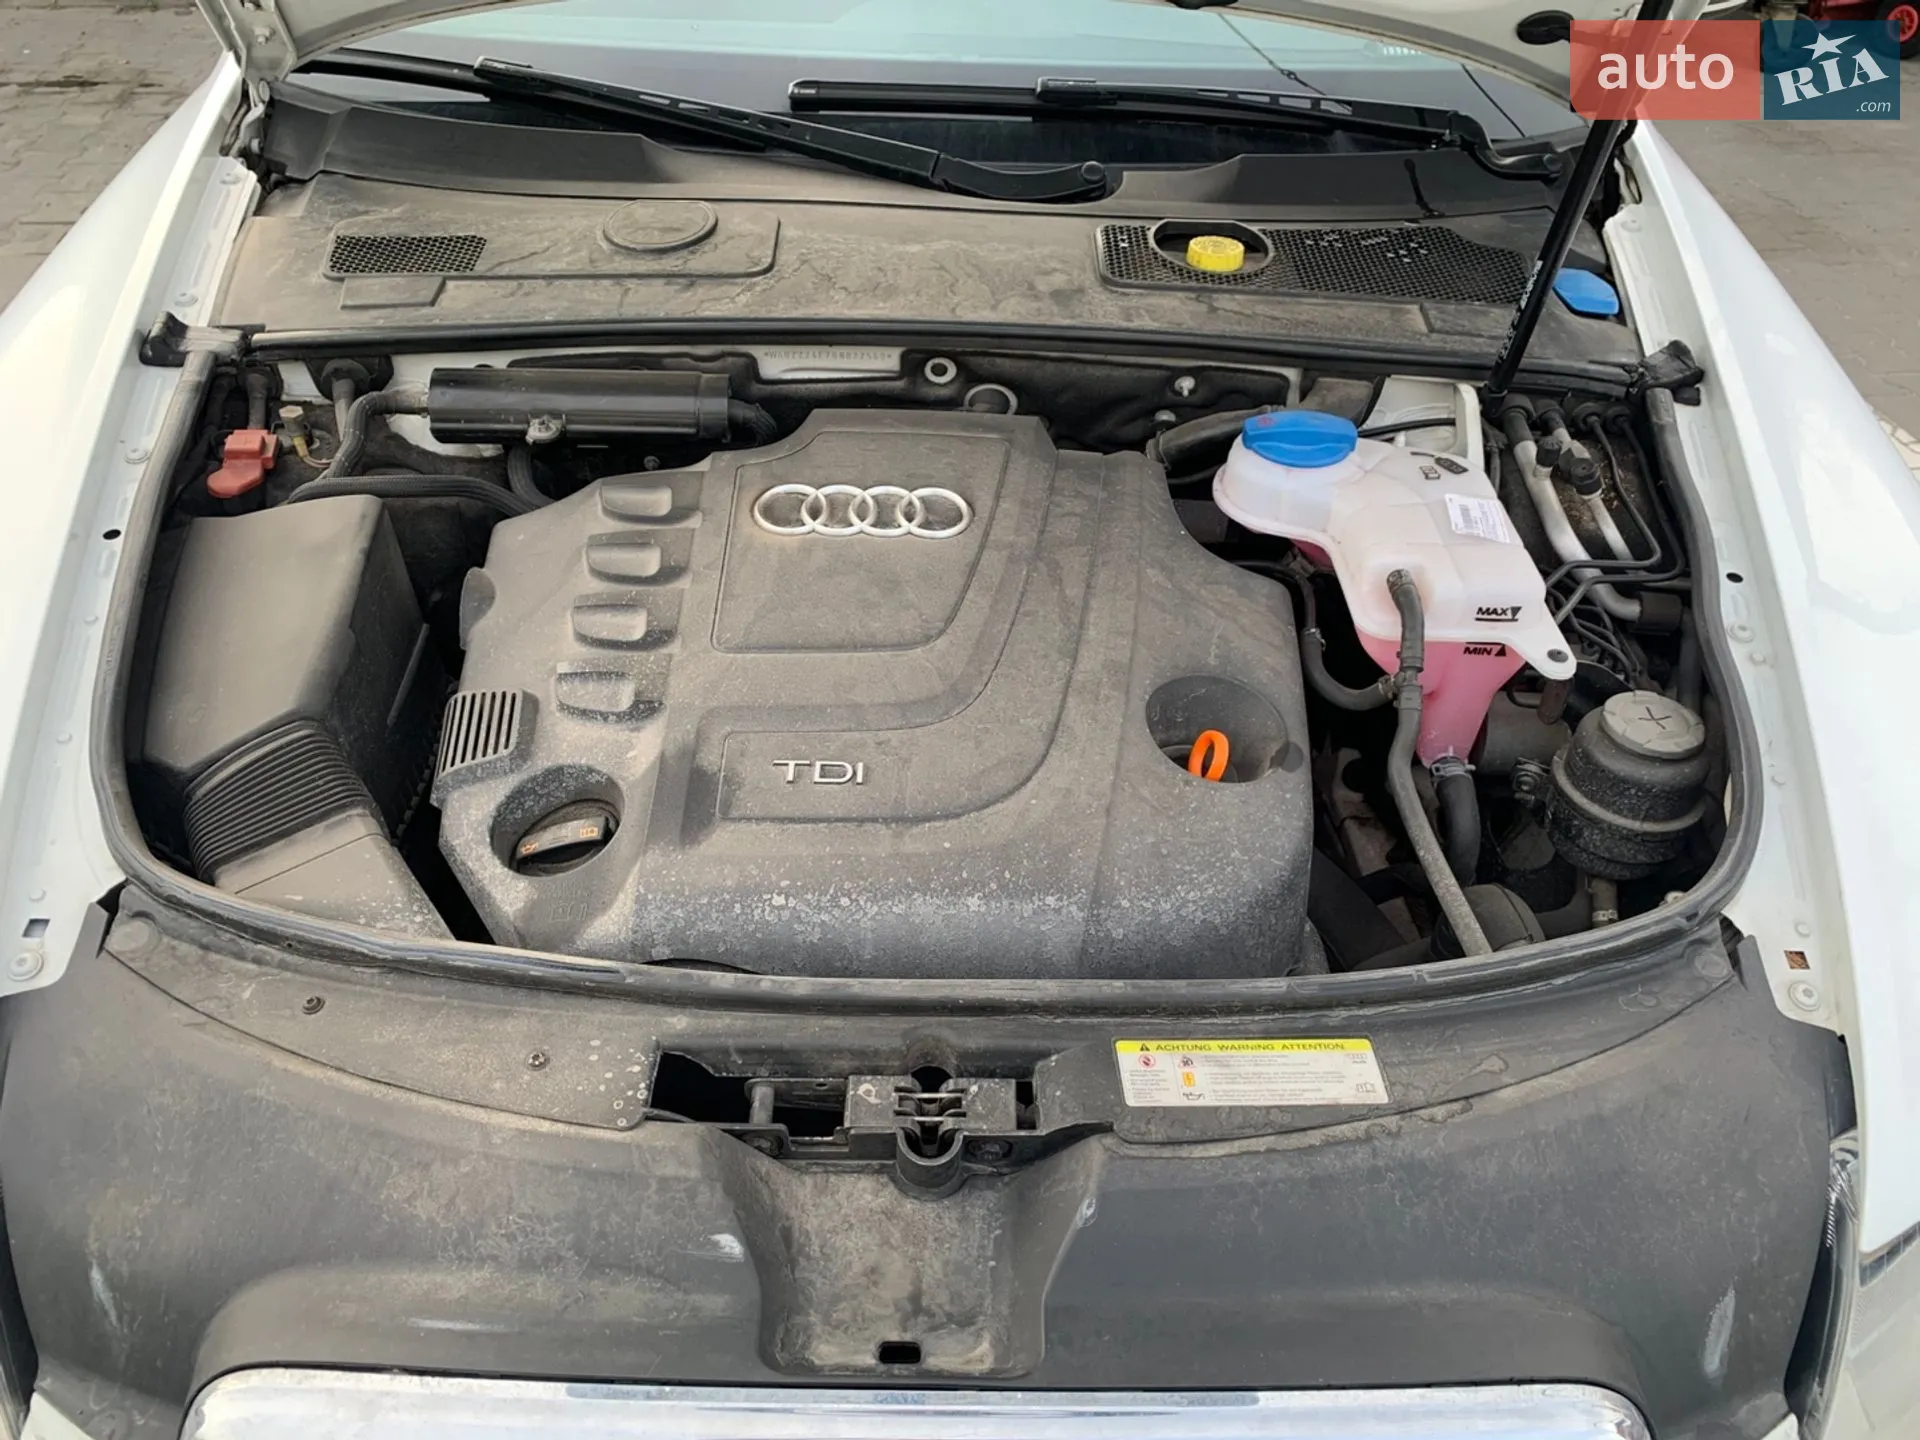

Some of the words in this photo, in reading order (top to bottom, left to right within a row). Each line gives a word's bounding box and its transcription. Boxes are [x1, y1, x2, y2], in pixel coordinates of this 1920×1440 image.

[1476, 606, 1508, 616] MAX
[1463, 646, 1492, 656] MIN
[772, 759, 864, 785] TDI
[1156, 1043, 1212, 1052] ACHTUNG
[1217, 1042, 1275, 1051] WARNING
[1281, 1042, 1345, 1051] ATTENTION
